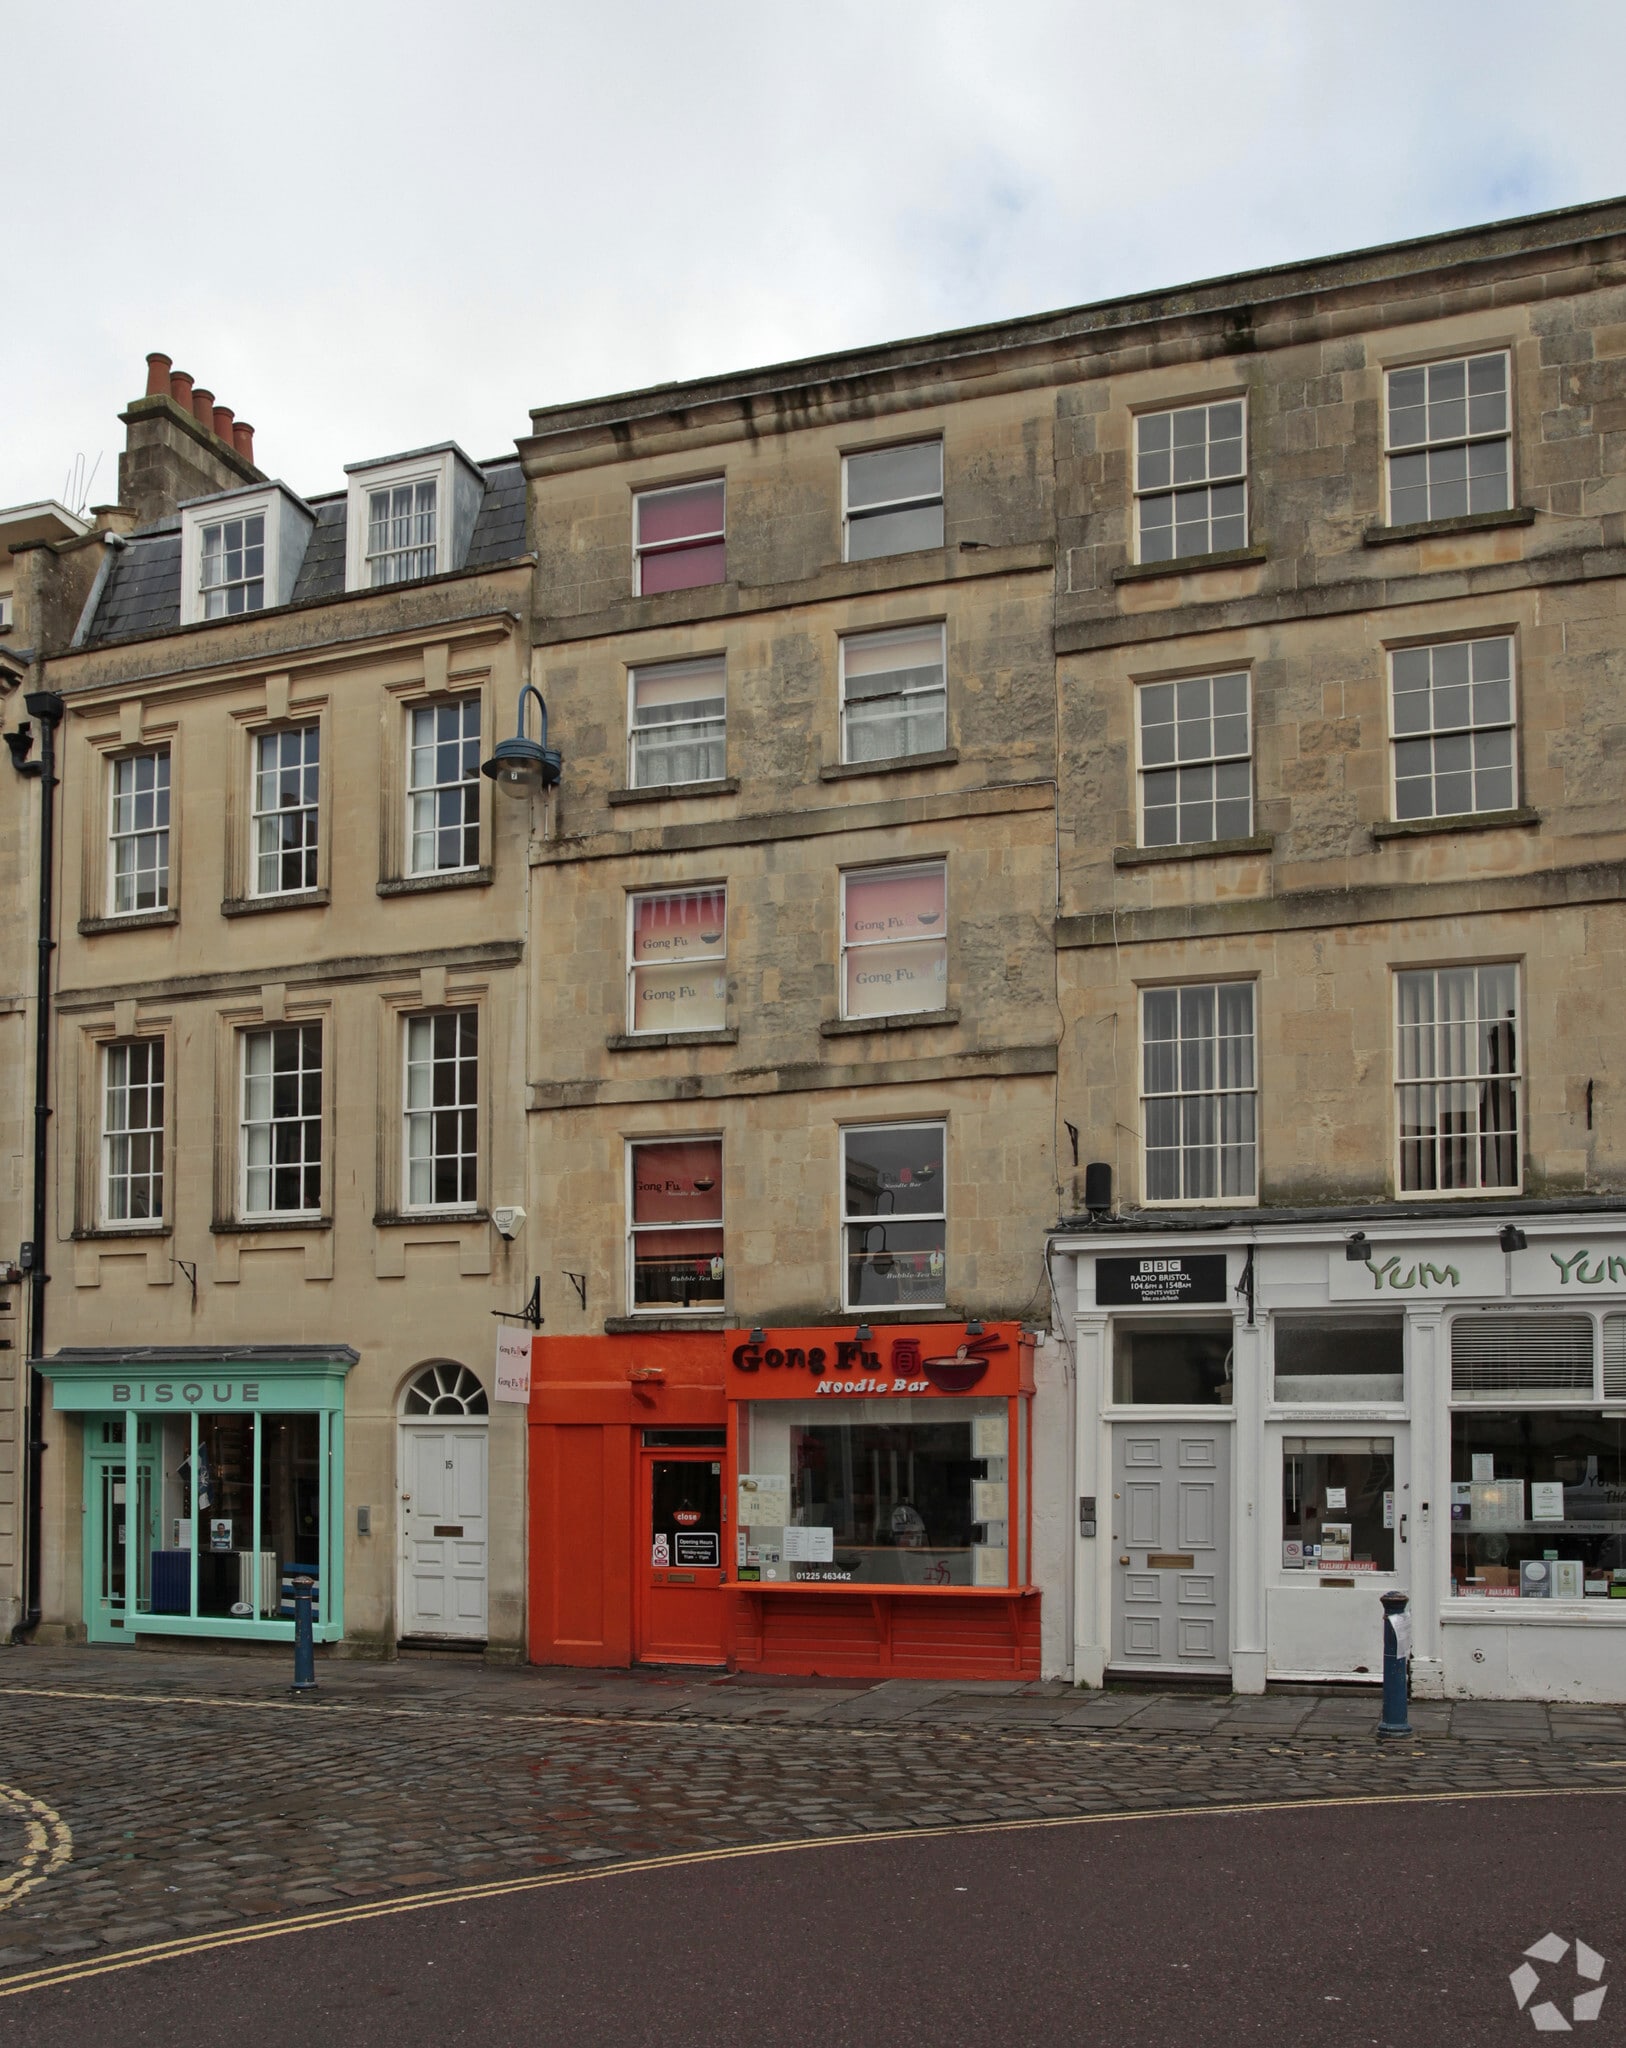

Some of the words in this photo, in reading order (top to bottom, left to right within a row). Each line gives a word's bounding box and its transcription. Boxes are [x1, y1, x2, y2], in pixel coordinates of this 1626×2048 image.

[854, 920, 885, 931] Gong
[888, 917, 904, 928] Fu
[642, 939, 671, 949] Gong
[673, 936, 688, 946] Fu
[856, 972, 892, 985] Gong
[896, 968, 915, 981] Fu
[642, 989, 676, 1001] Gong
[679, 986, 696, 998] Fu
[635, 1181, 662, 1192] Gong
[665, 1180, 681, 1191] Fu
[1141, 1260, 1180, 1272] BBC
[1130, 1274, 1157, 1282] RADIO
[1158, 1273, 1191, 1281] BRISTOL
[732, 1341, 826, 1375] Gong
[834, 1341, 882, 1371] Fu
[815, 1378, 888, 1394] Noodle
[891, 1377, 929, 1392] Bar
[112, 1383, 260, 1405] BISQUE
[445, 1460, 454, 1470] 15
[677, 1513, 697, 1521] close
[1319, 1562, 1346, 1570] TAKEAWAY
[1346, 1562, 1374, 1570] AVAILABLE
[796, 1572, 820, 1580] 01225
[822, 1572, 851, 1580] 463442
[1487, 1588, 1516, 1596] AVAILABLE
